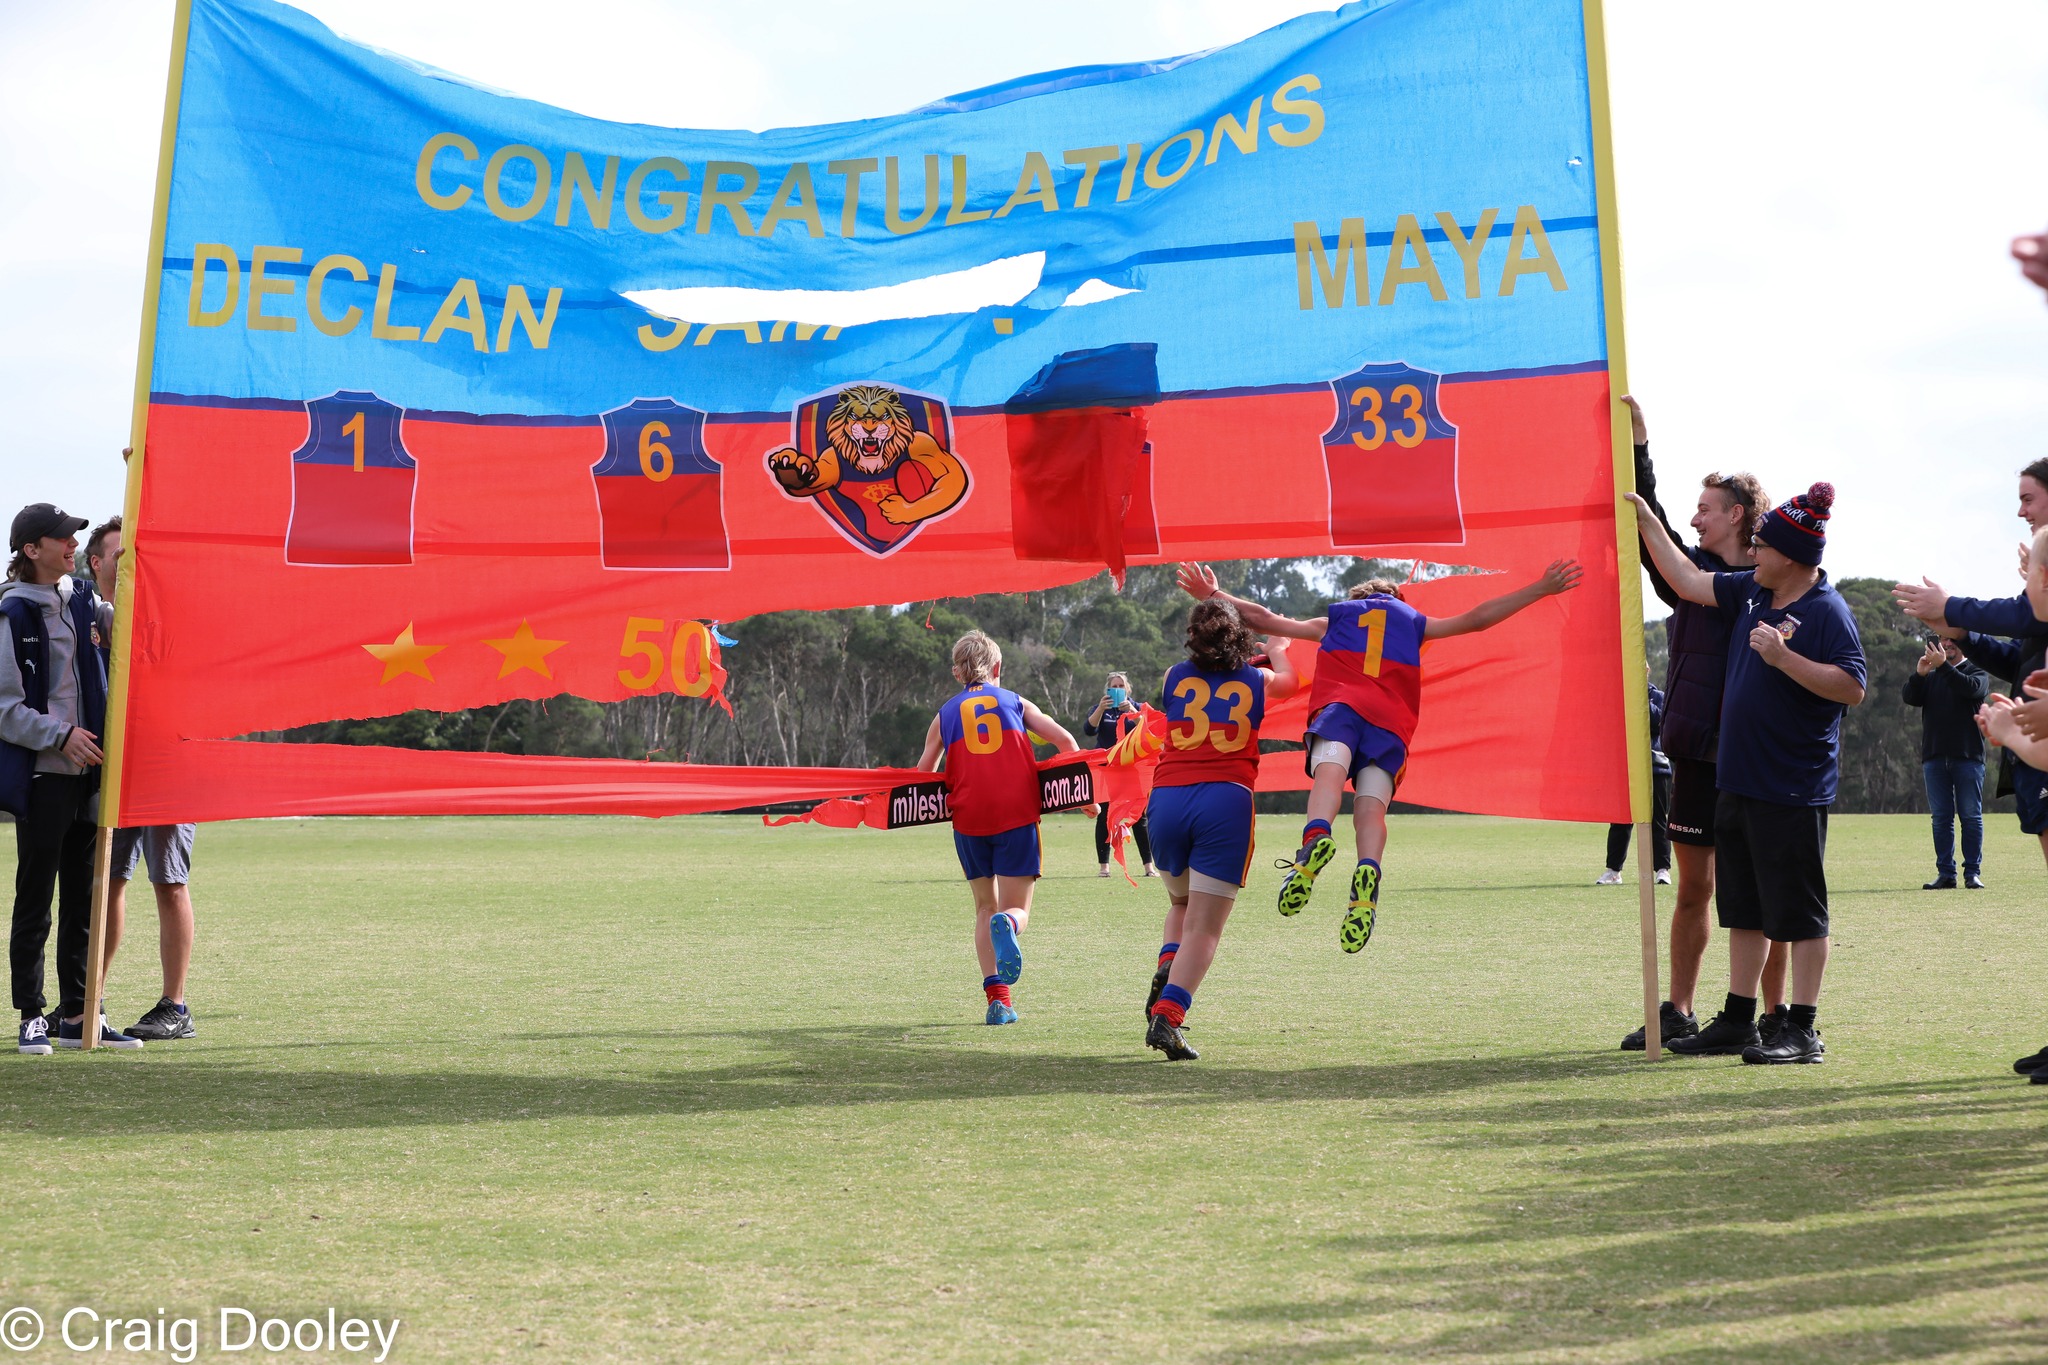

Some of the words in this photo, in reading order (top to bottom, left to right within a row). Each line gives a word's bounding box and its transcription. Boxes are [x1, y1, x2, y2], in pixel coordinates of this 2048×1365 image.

[415, 73, 1326, 238] CONGRATULATIONS
[1293, 204, 1569, 310] MAYA
[187, 243, 563, 352] DECLAN
[341, 412, 364, 472] 1
[1350, 384, 1427, 450] 33
[638, 421, 673, 481] 6
[1357, 608, 1387, 678] 1
[960, 695, 1003, 755] 6
[1170, 677, 1254, 754] 33
[1042, 774, 1090, 809] .com.au
[1669, 822, 1703, 834] NISSAN
